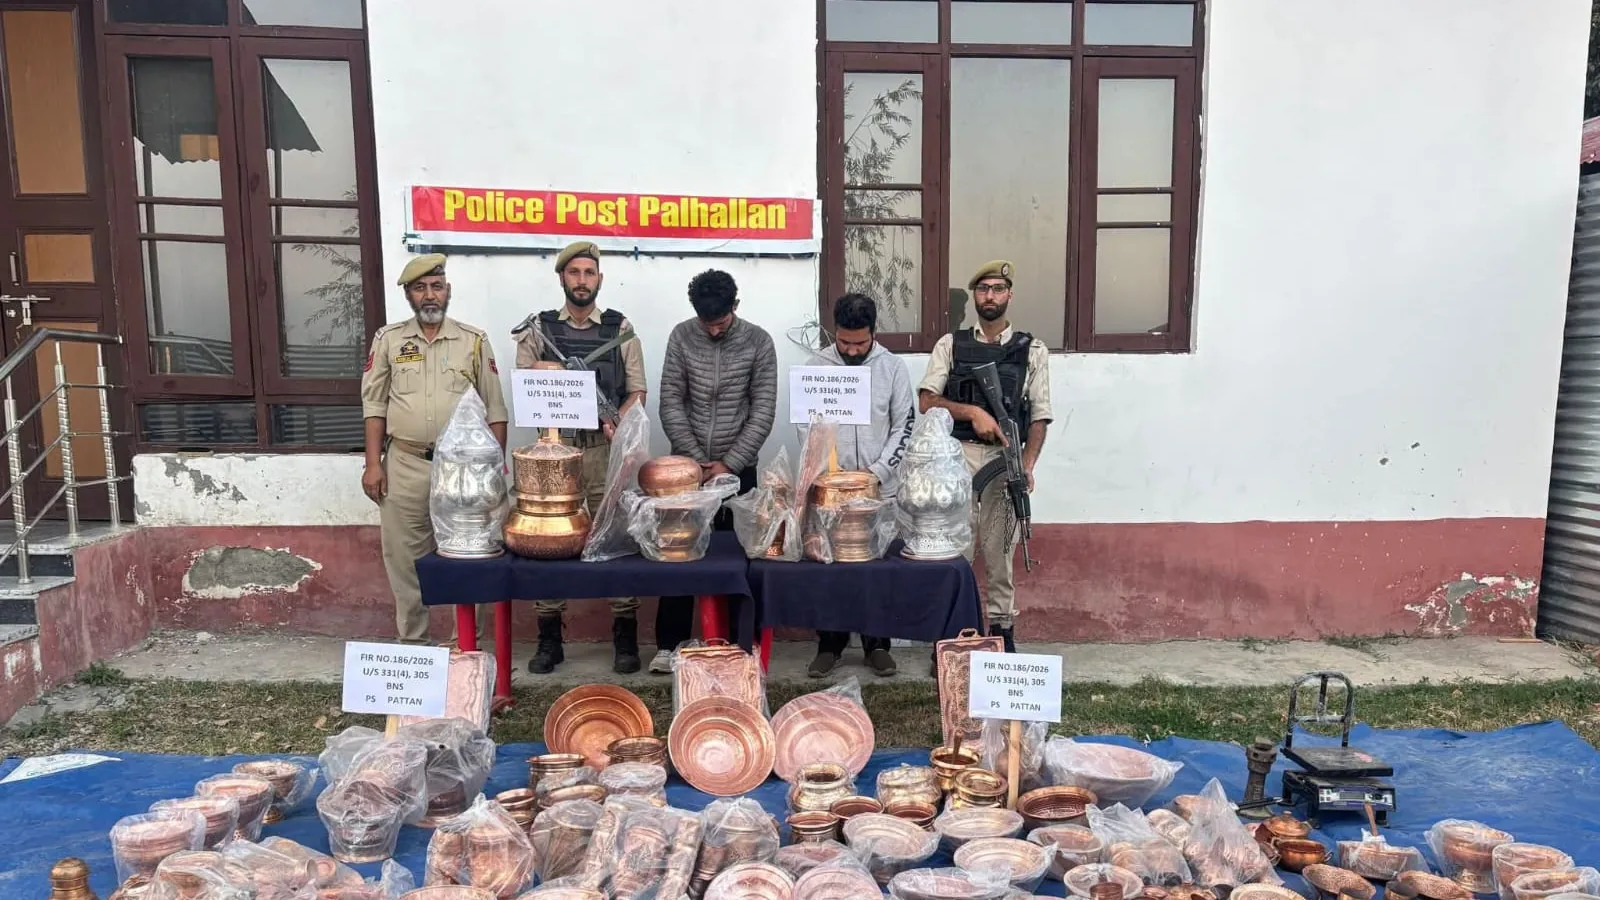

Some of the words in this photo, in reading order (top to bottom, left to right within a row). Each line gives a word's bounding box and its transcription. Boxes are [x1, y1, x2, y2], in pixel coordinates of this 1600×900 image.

[445, 189, 545, 224] Police
[556, 193, 628, 226] Post
[639, 196, 786, 229] Palhallan
[523, 378, 535, 386] FIR
[536, 379, 584, 387] NO.186/2026
[814, 375, 860, 384] NO.186/2026
[360, 653, 374, 661] FIR
[376, 655, 434, 666] NO.186/2026
[998, 663, 1049, 673] NO.186/2026
[363, 668, 379, 676] U/S
[413, 671, 429, 679] 305
[986, 676, 1001, 684] U/S
[1031, 678, 1046, 686] 305
[386, 682, 404, 690] BNS
[1008, 689, 1024, 697] BNS
[387, 696, 423, 705] PATTAN
[1010, 702, 1041, 711] PATTAN
